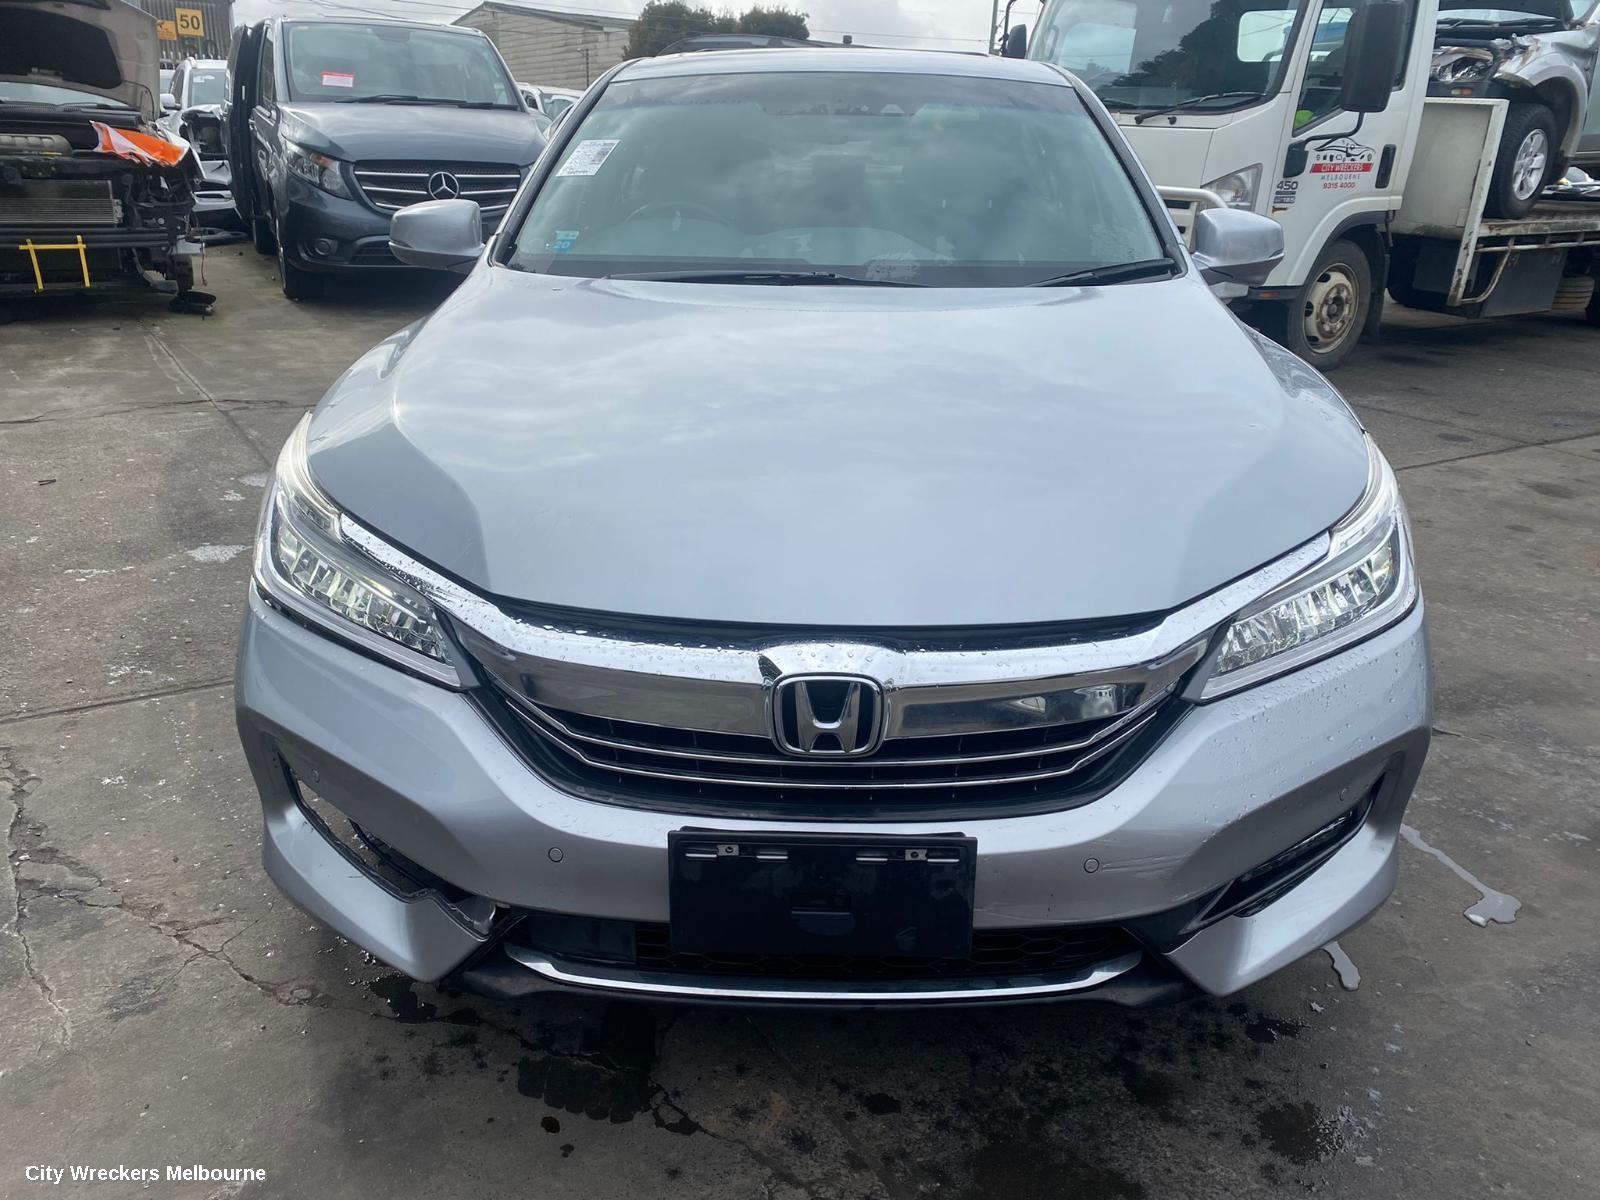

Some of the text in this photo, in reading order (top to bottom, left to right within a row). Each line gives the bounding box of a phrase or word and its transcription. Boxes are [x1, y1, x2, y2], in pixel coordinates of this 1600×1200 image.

[180, 14, 200, 30] 50
[1321, 163, 1363, 172] CITY WRECKERS
[1276, 180, 1298, 190] 450
